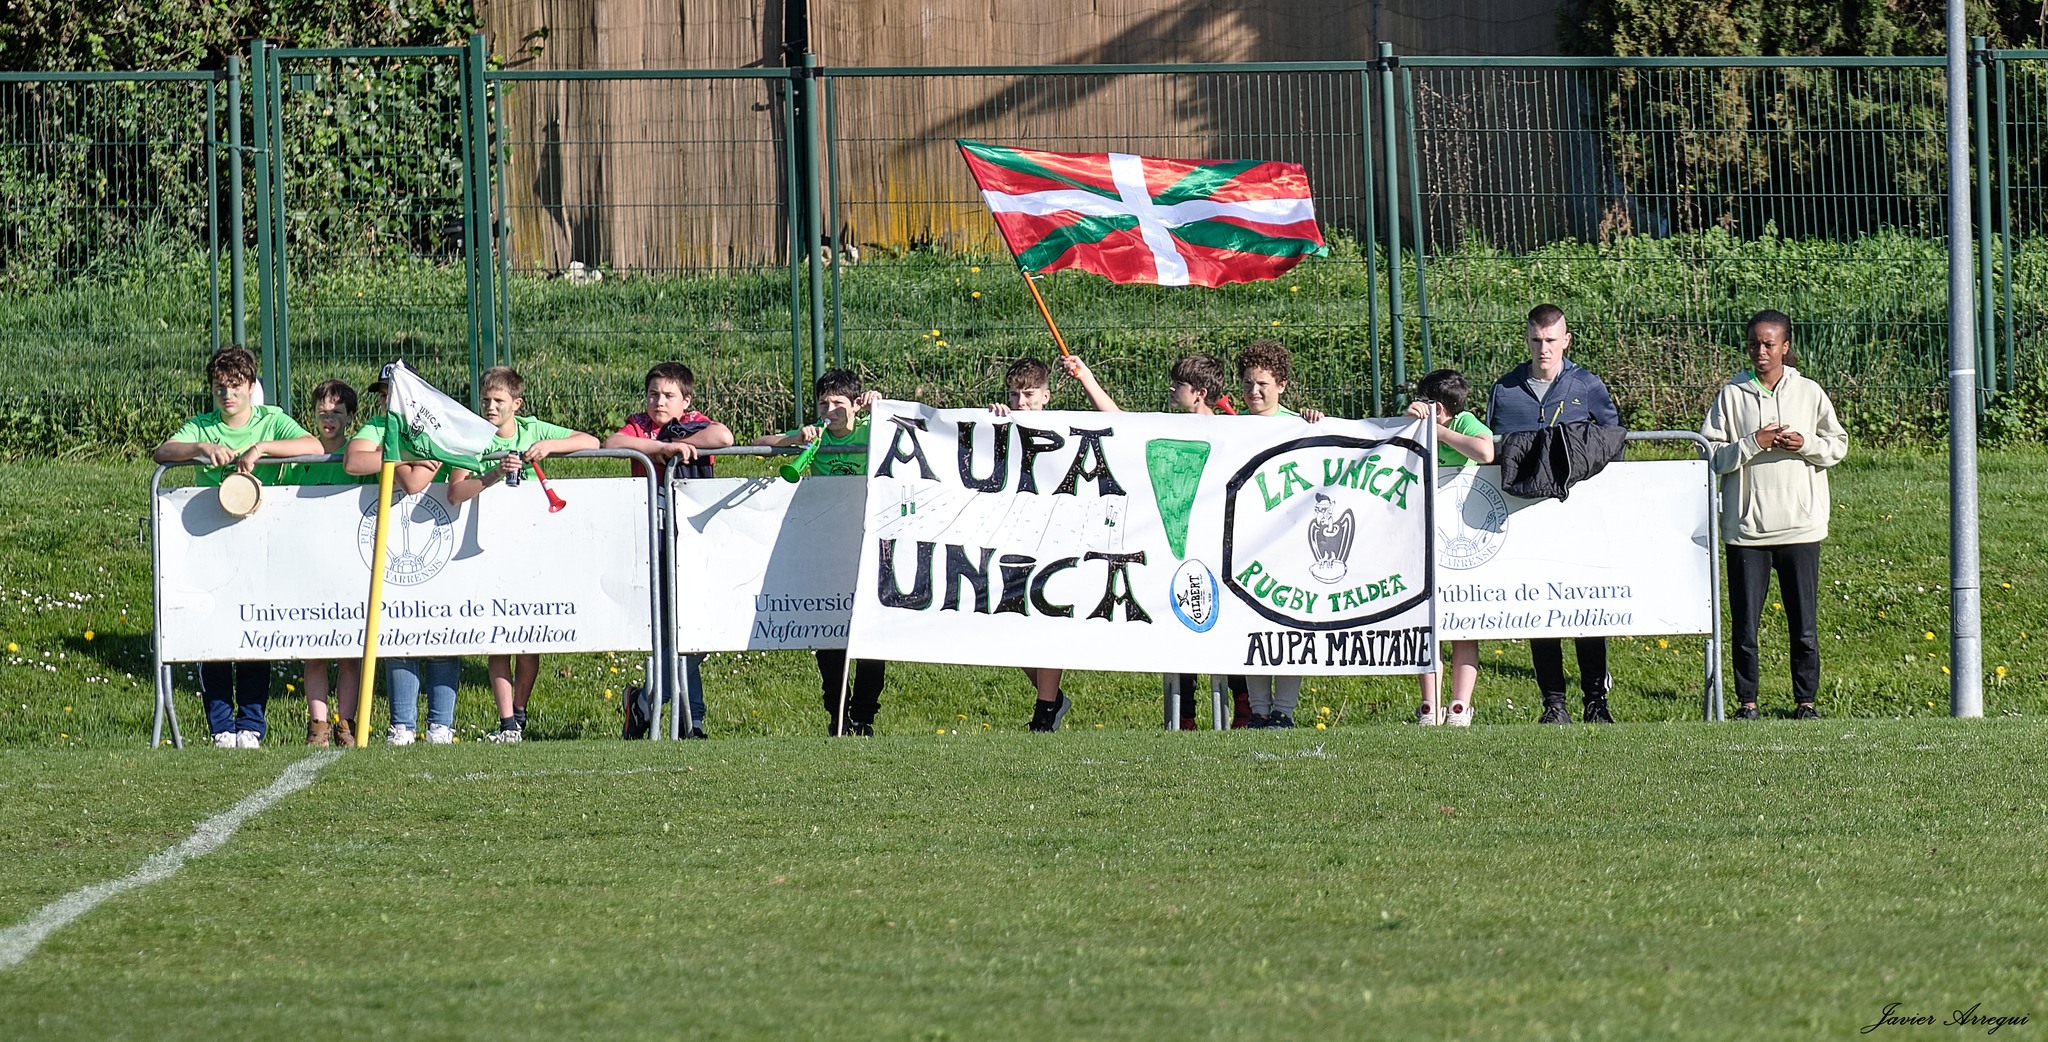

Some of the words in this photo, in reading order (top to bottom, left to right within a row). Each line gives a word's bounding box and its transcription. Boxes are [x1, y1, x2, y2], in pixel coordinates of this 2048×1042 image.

[875, 414, 1126, 497] AUPA
[1255, 460, 1314, 512] LA
[1189, 575, 1202, 619] GILBERT
[1235, 560, 1319, 614] RUGBY
[1328, 573, 1407, 613] TALDEA
[1438, 584, 1508, 603] ública
[1514, 583, 1540, 601] de
[1546, 581, 1633, 600] Navarra
[239, 602, 366, 622] Universidad
[459, 599, 485, 617] de
[491, 598, 577, 617] Navarra
[1438, 610, 1542, 631] ibertsitate
[1545, 607, 1634, 629] Publikoa
[239, 628, 352, 652] Nafarroako
[489, 625, 578, 645] Publikoa
[1243, 630, 1317, 666] AUPA
